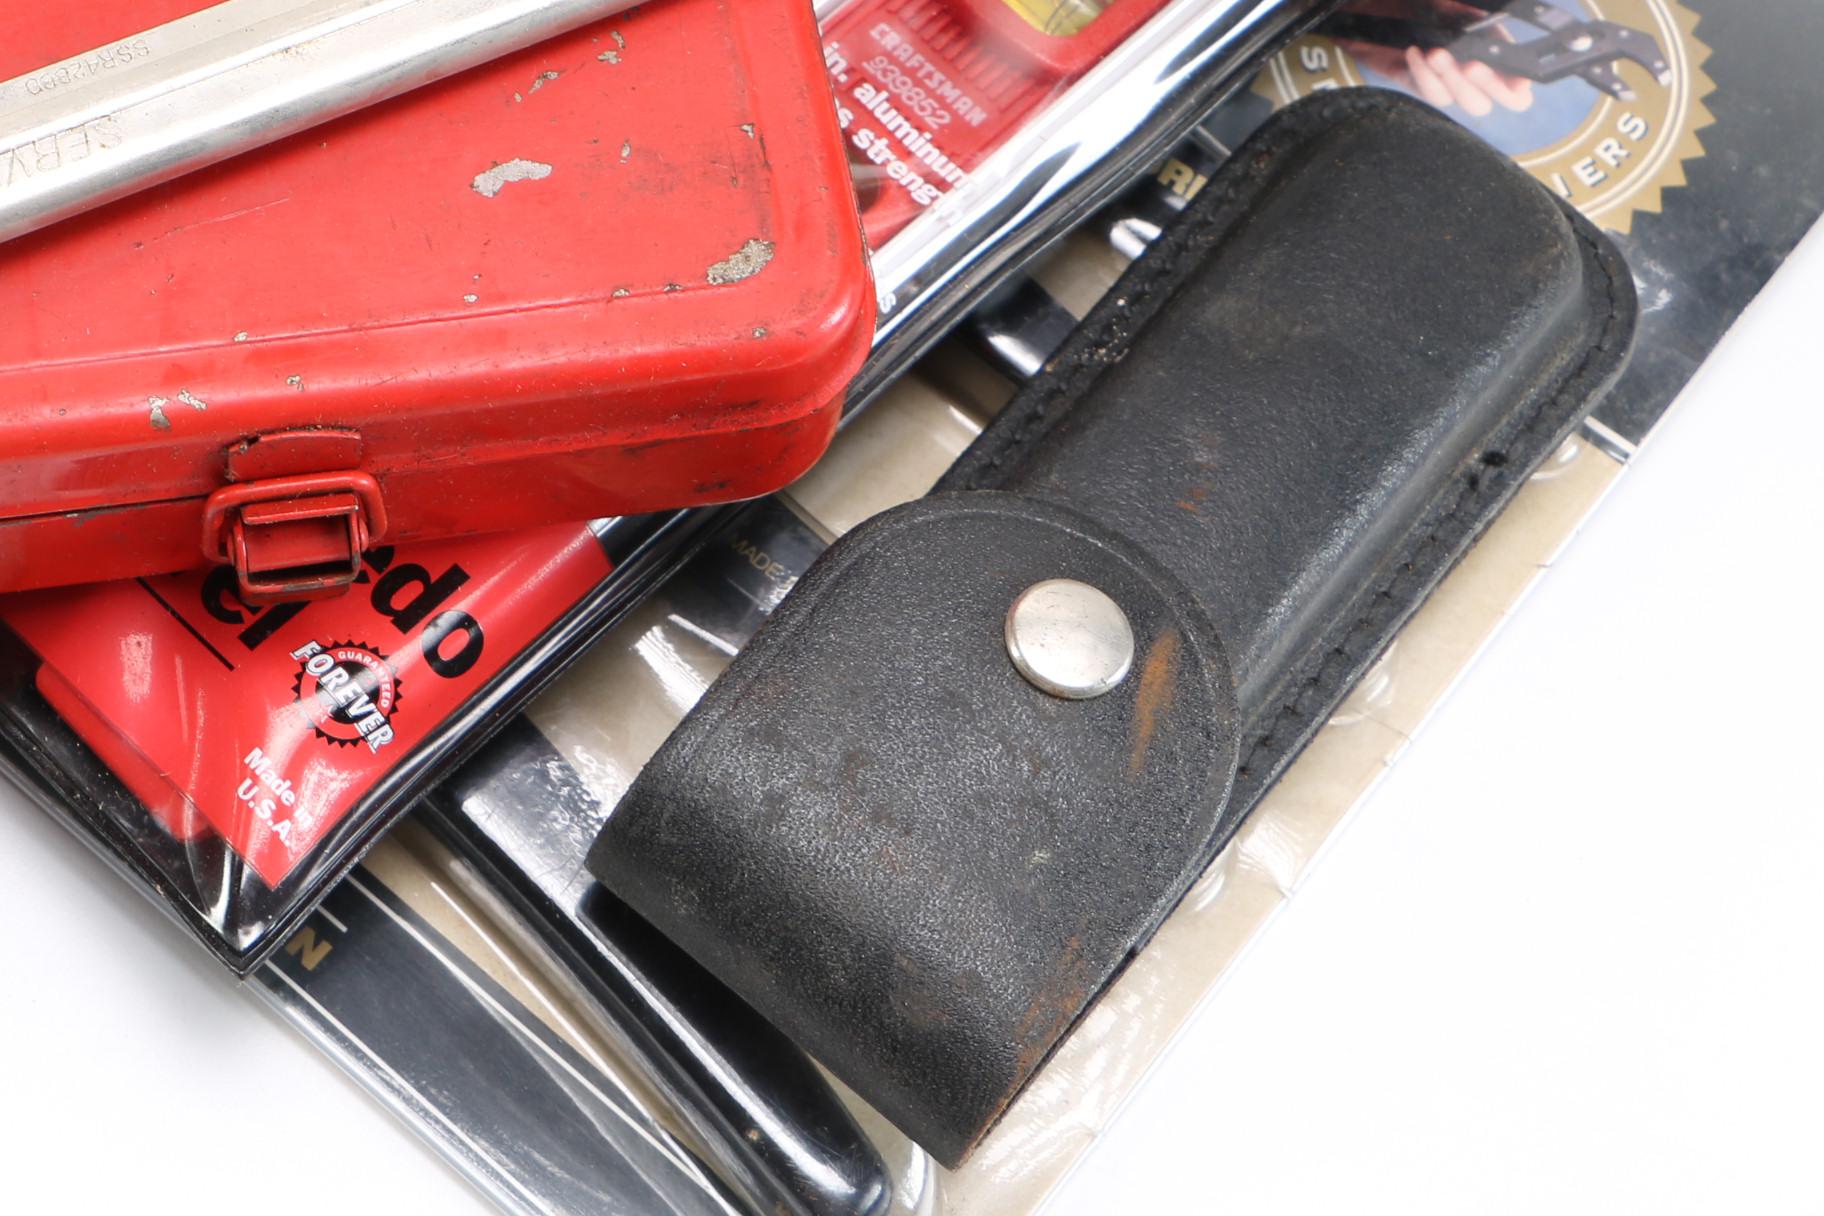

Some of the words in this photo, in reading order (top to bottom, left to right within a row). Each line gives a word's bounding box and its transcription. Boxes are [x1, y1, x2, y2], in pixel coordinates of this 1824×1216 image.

[867, 18, 988, 129] CRAFTSMAN
[289, 634, 398, 757] FOREVER
[233, 776, 302, 847] U.S.A.
[242, 746, 302, 808] Made
